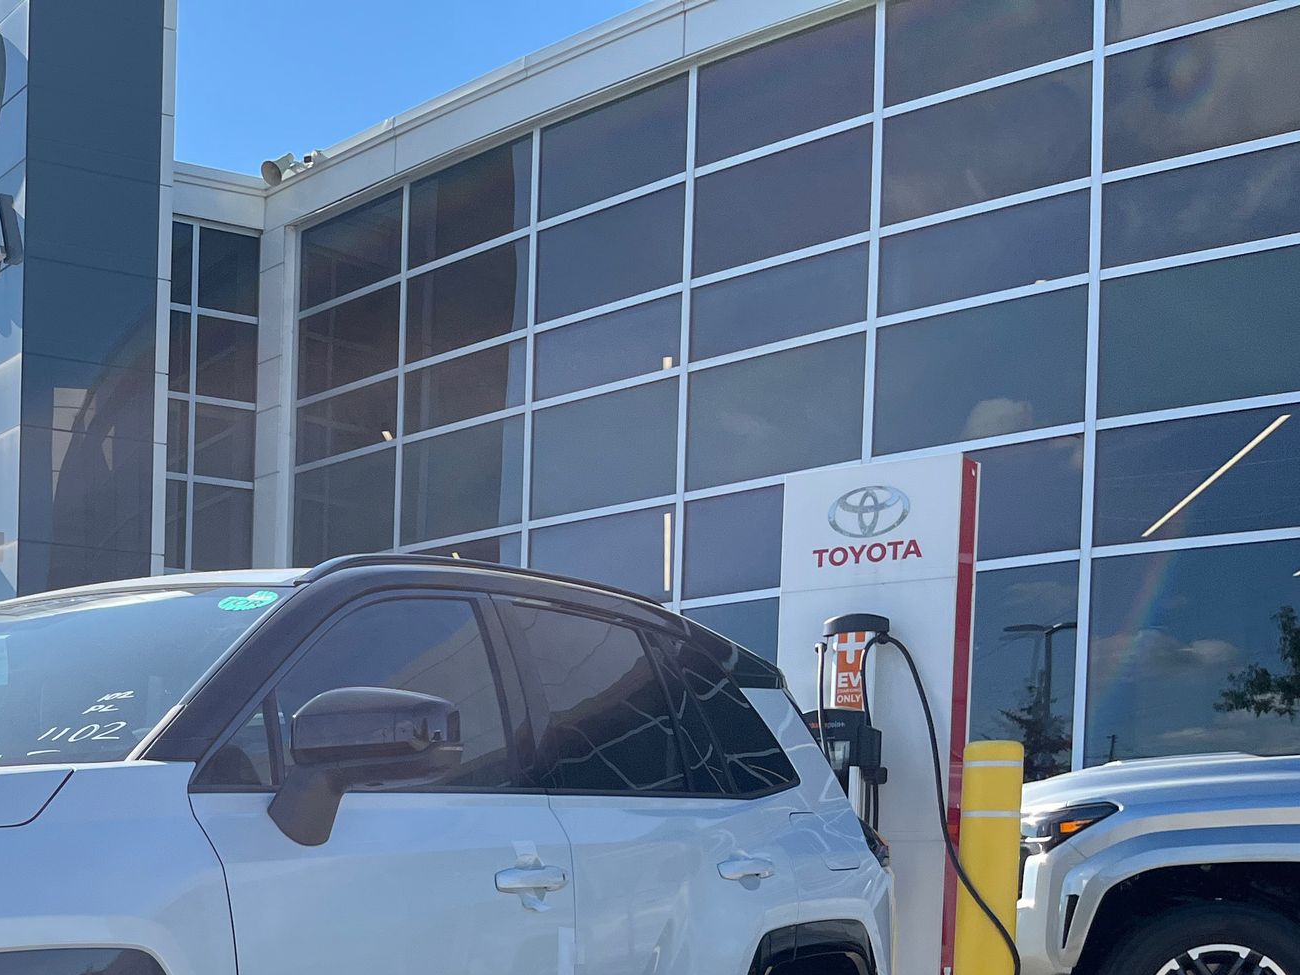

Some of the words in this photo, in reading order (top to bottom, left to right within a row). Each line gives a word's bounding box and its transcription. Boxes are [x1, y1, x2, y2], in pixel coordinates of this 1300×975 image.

[812, 539, 922, 568] TOYOTA
[838, 671, 861, 688] EV
[836, 694, 862, 704] ONLY
[37, 721, 127, 743] 1102
